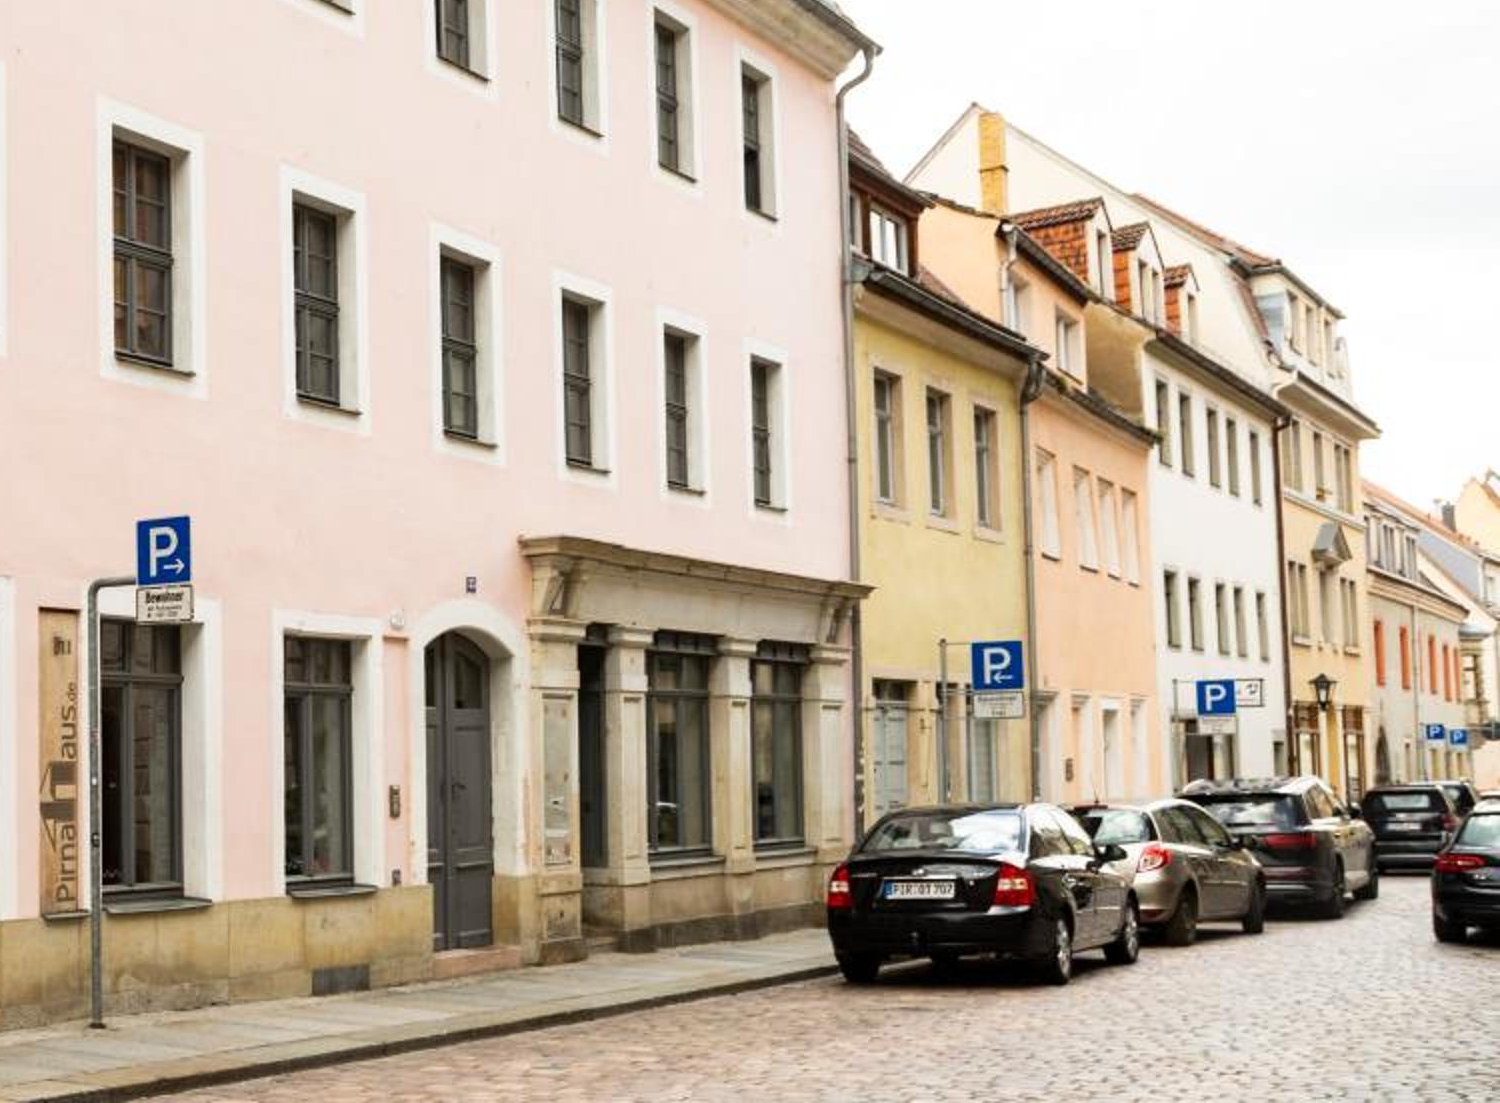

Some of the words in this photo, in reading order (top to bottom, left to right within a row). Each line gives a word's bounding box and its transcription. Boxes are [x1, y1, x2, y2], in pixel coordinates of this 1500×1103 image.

[149, 526, 179, 578] P
[983, 647, 1011, 685] P
[1205, 684, 1227, 712] P
